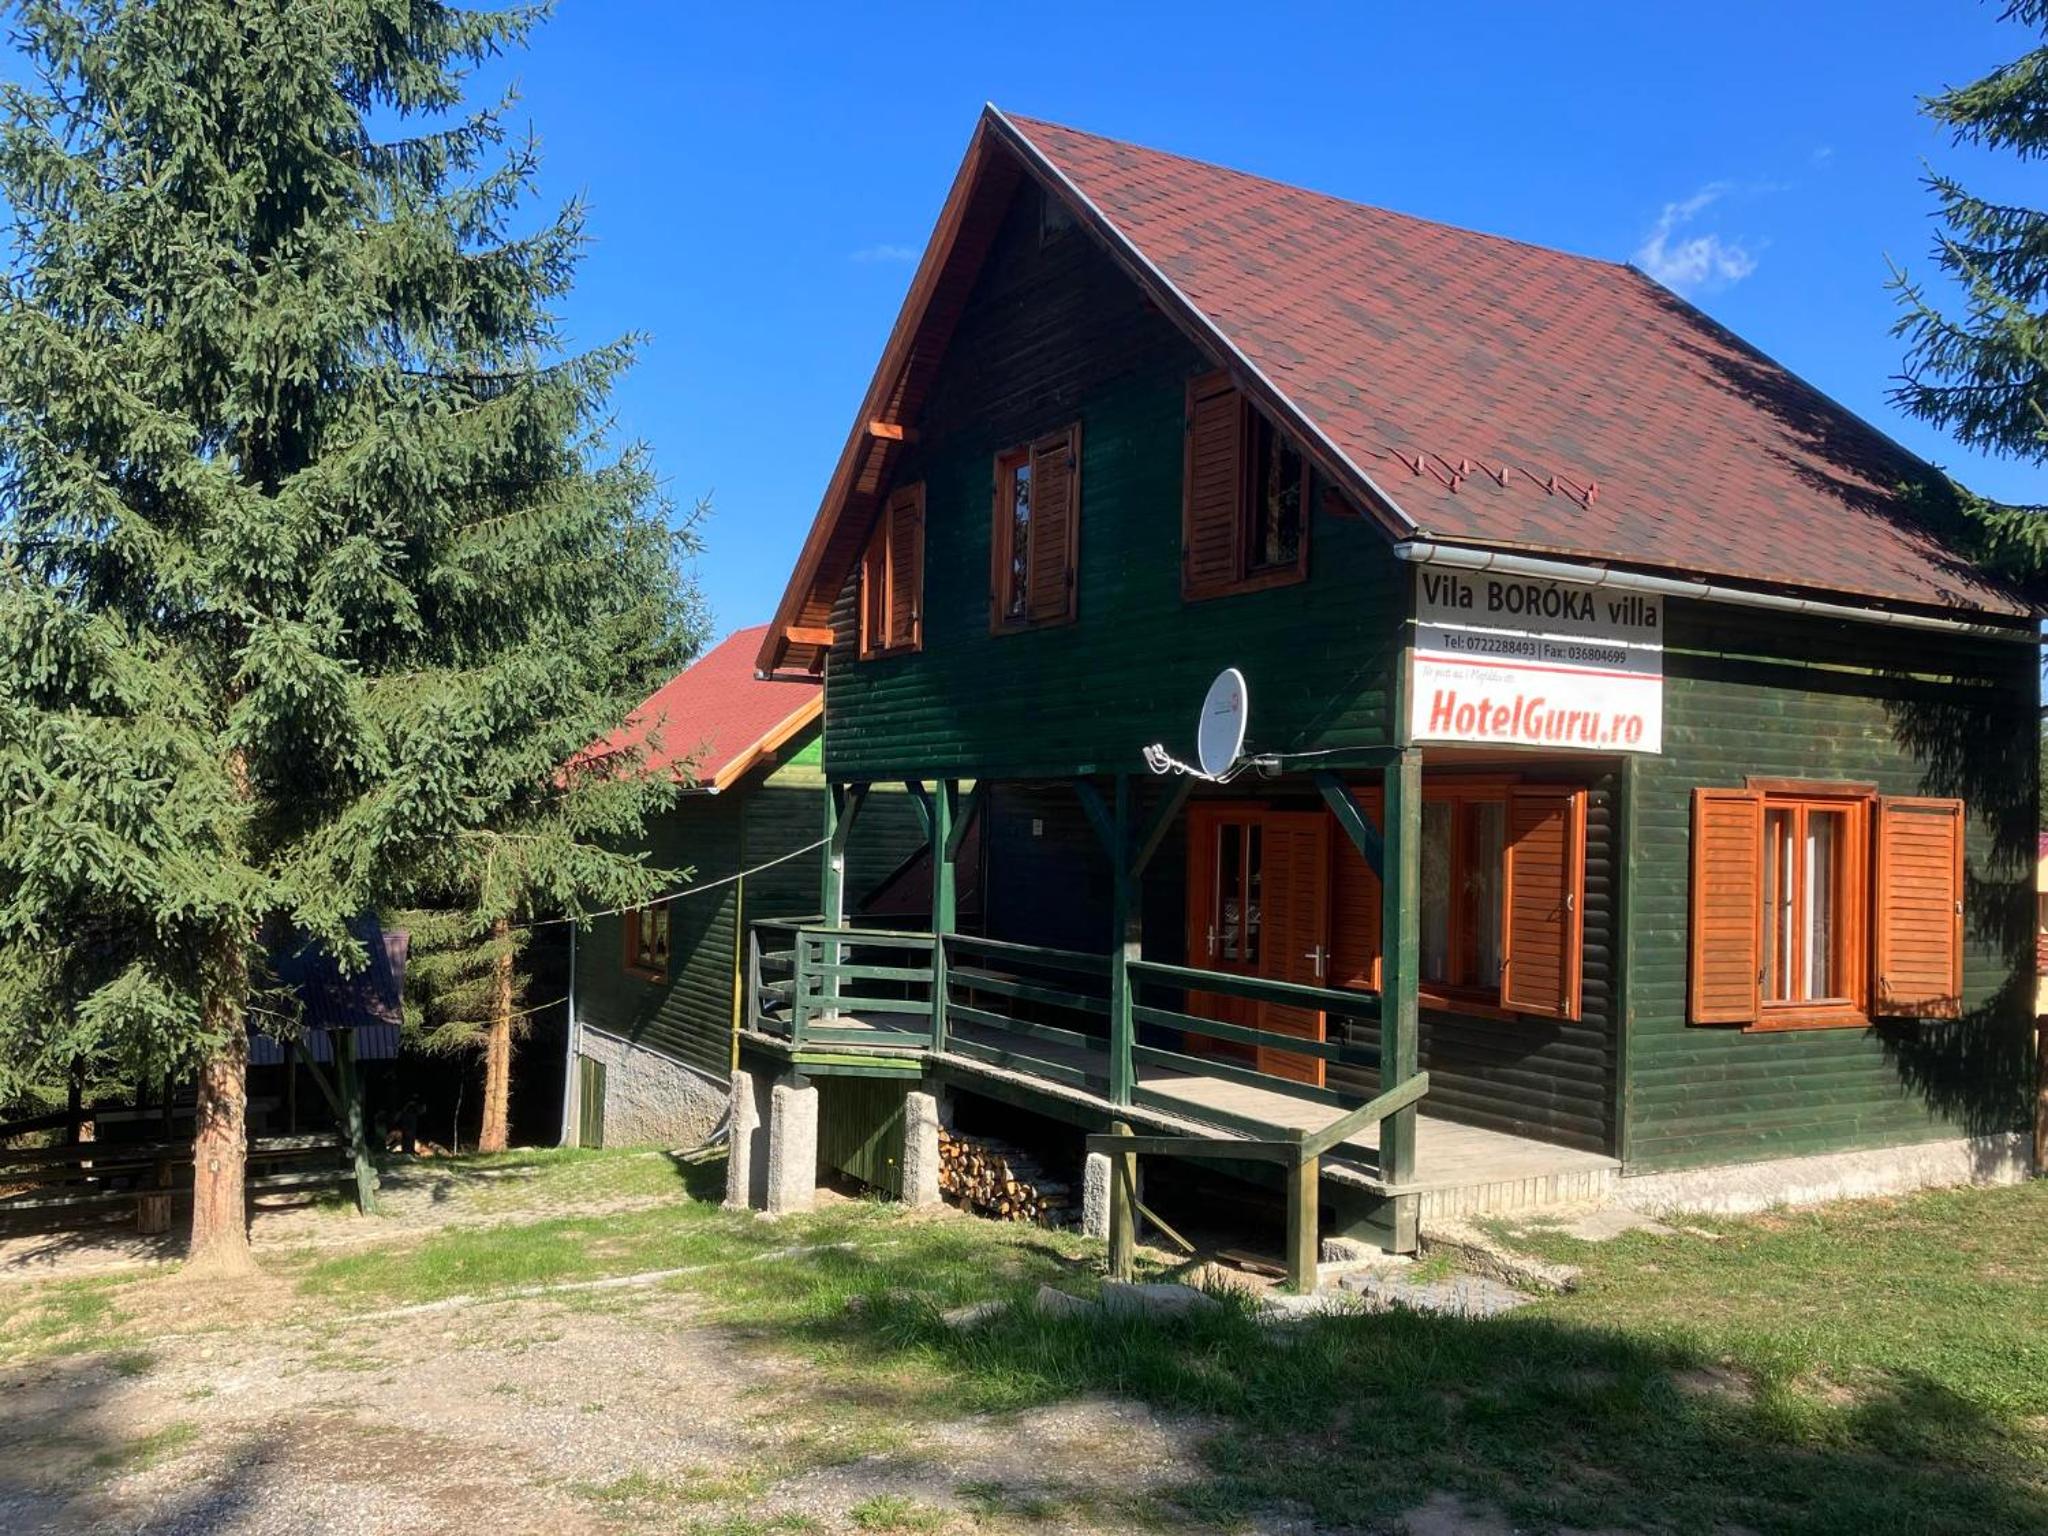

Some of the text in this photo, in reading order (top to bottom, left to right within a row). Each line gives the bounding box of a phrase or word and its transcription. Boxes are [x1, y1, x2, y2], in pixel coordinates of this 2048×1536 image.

[1423, 574, 1657, 627] Vila BORÓKA villa
[1444, 634, 1464, 649] Tel:
[1467, 637, 1536, 656] 0722288493
[1544, 644, 1566, 659] Fax:
[1429, 689, 1643, 744] HotelGuru.ro
